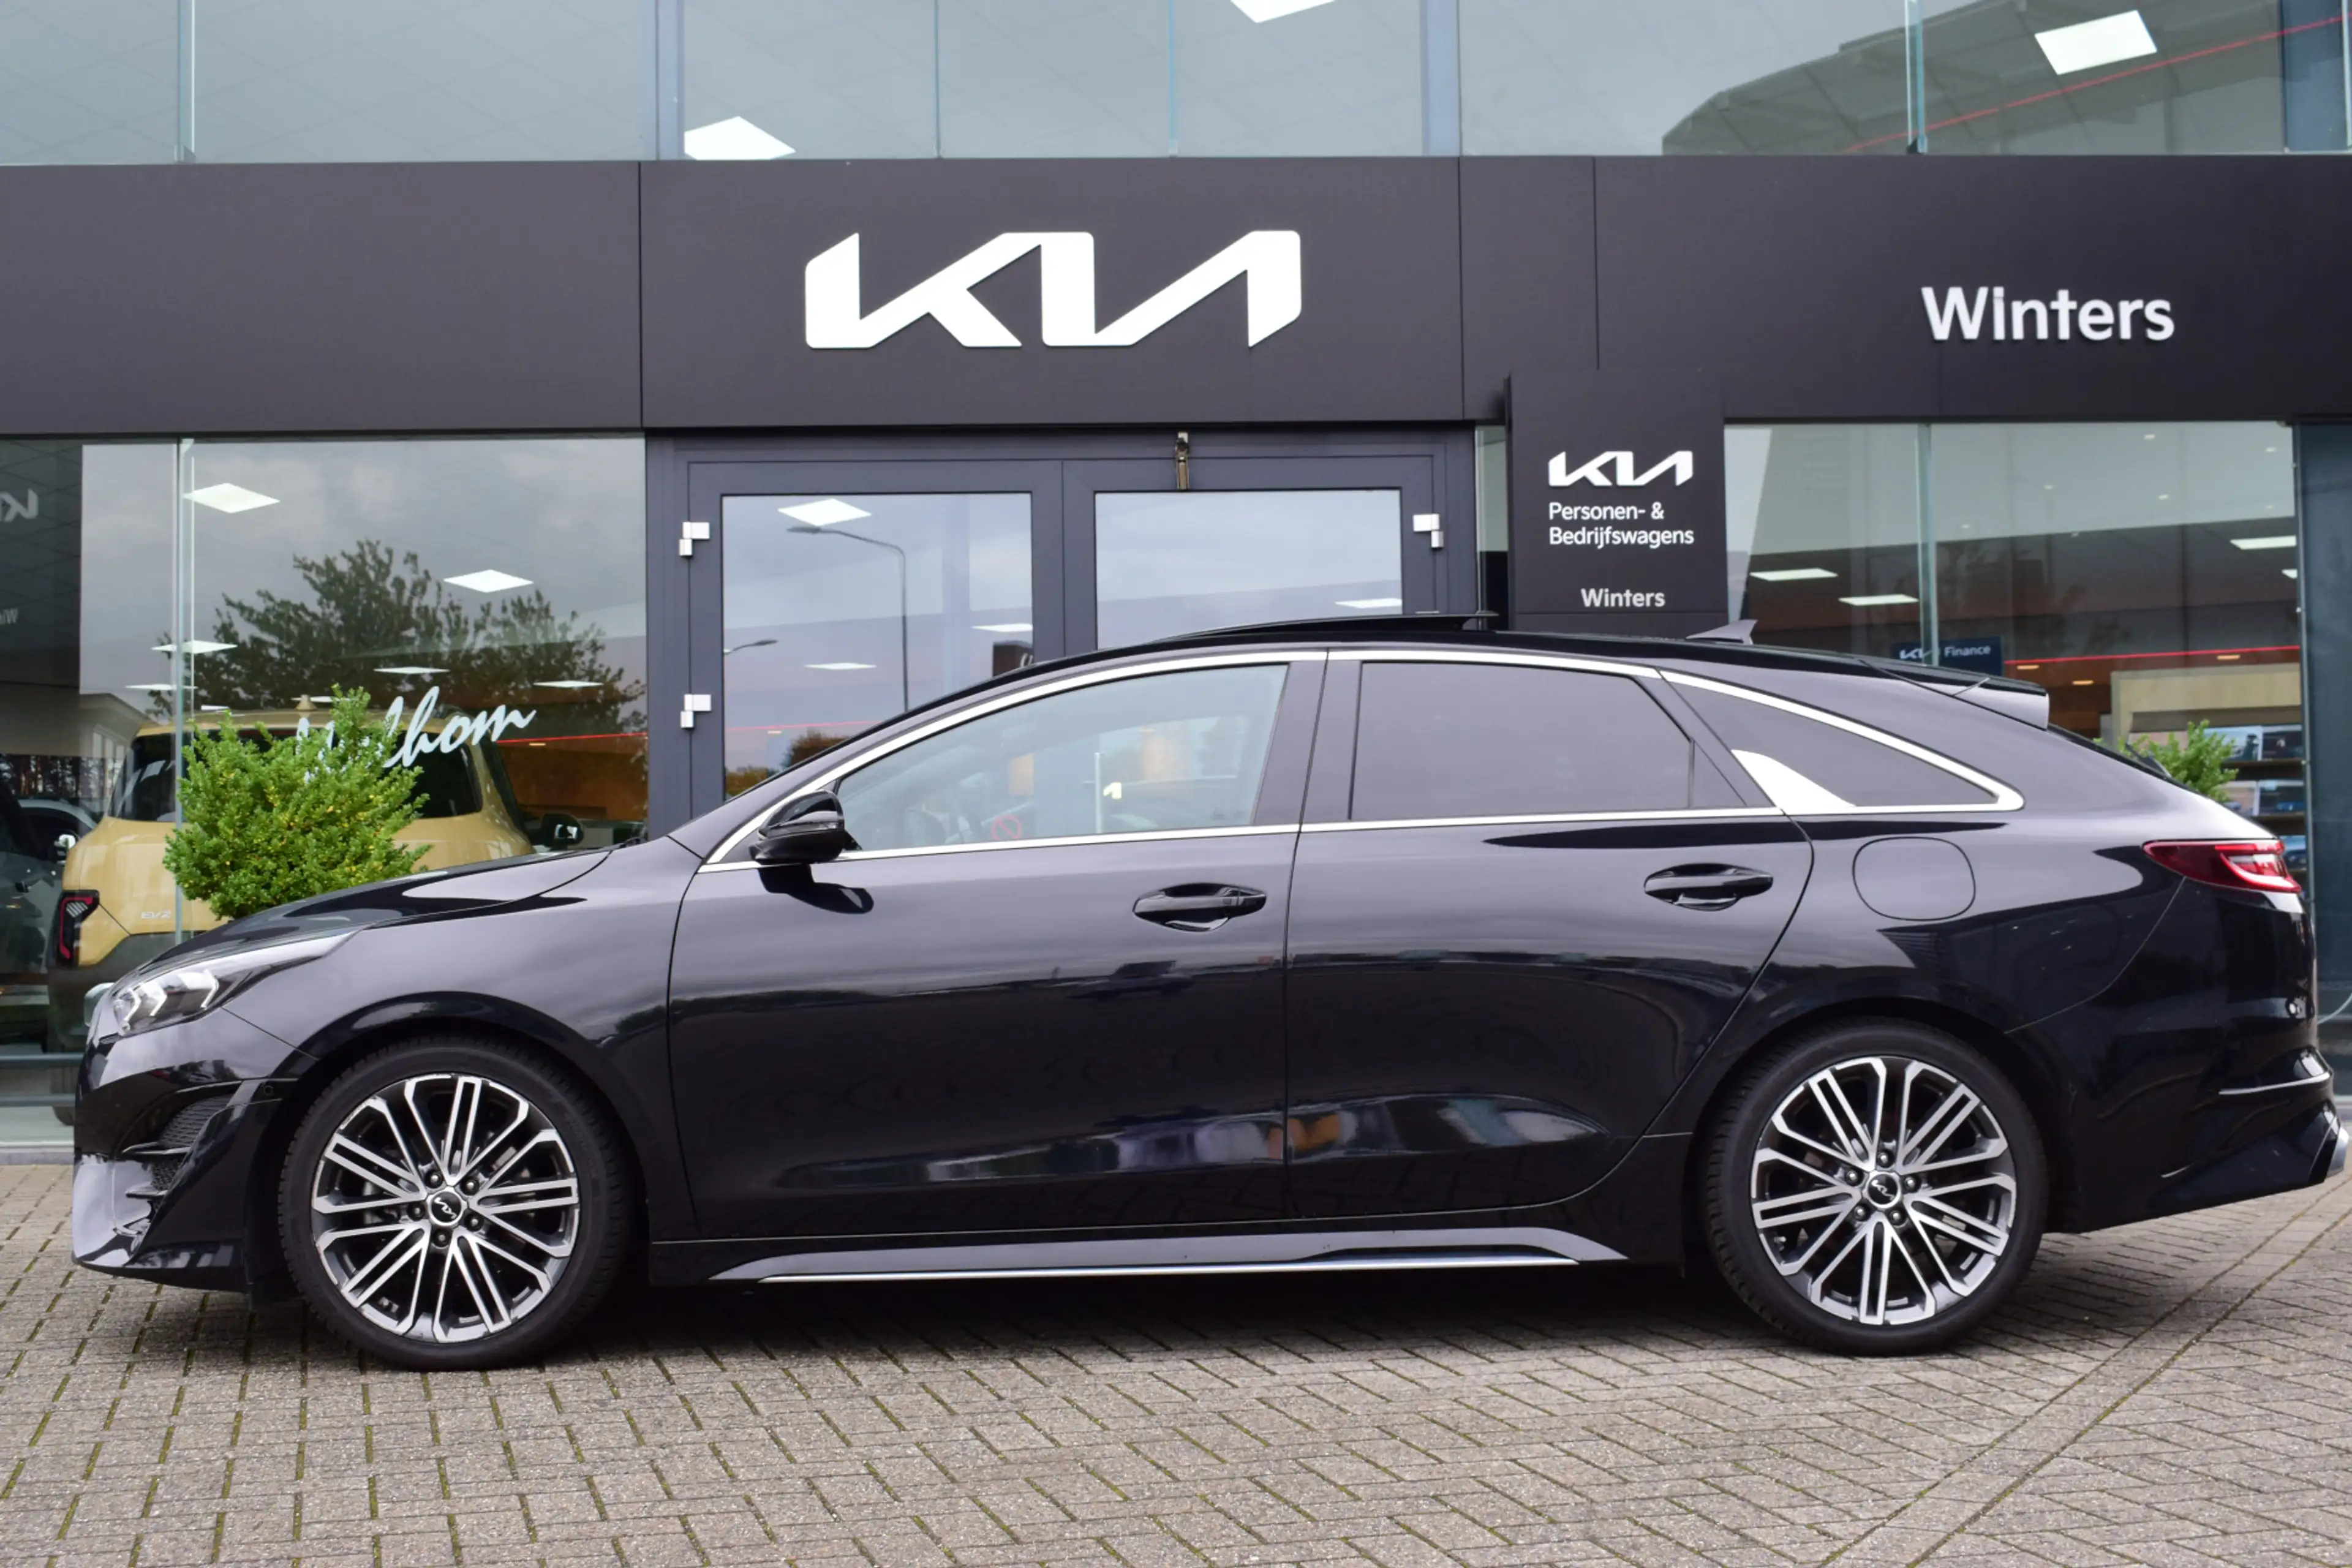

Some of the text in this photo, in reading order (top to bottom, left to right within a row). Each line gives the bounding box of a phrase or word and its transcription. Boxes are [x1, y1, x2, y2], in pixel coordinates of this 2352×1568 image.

[805, 230, 1302, 349] KIA
[1921, 286, 2175, 341] Winters
[1548, 450, 1694, 486] KIA
[1548, 502, 1665, 521] Personen- &
[1549, 526, 1695, 549] Bedrijfswagens
[1580, 588, 1666, 608] Winters
[1943, 645, 1991, 658] Finance
